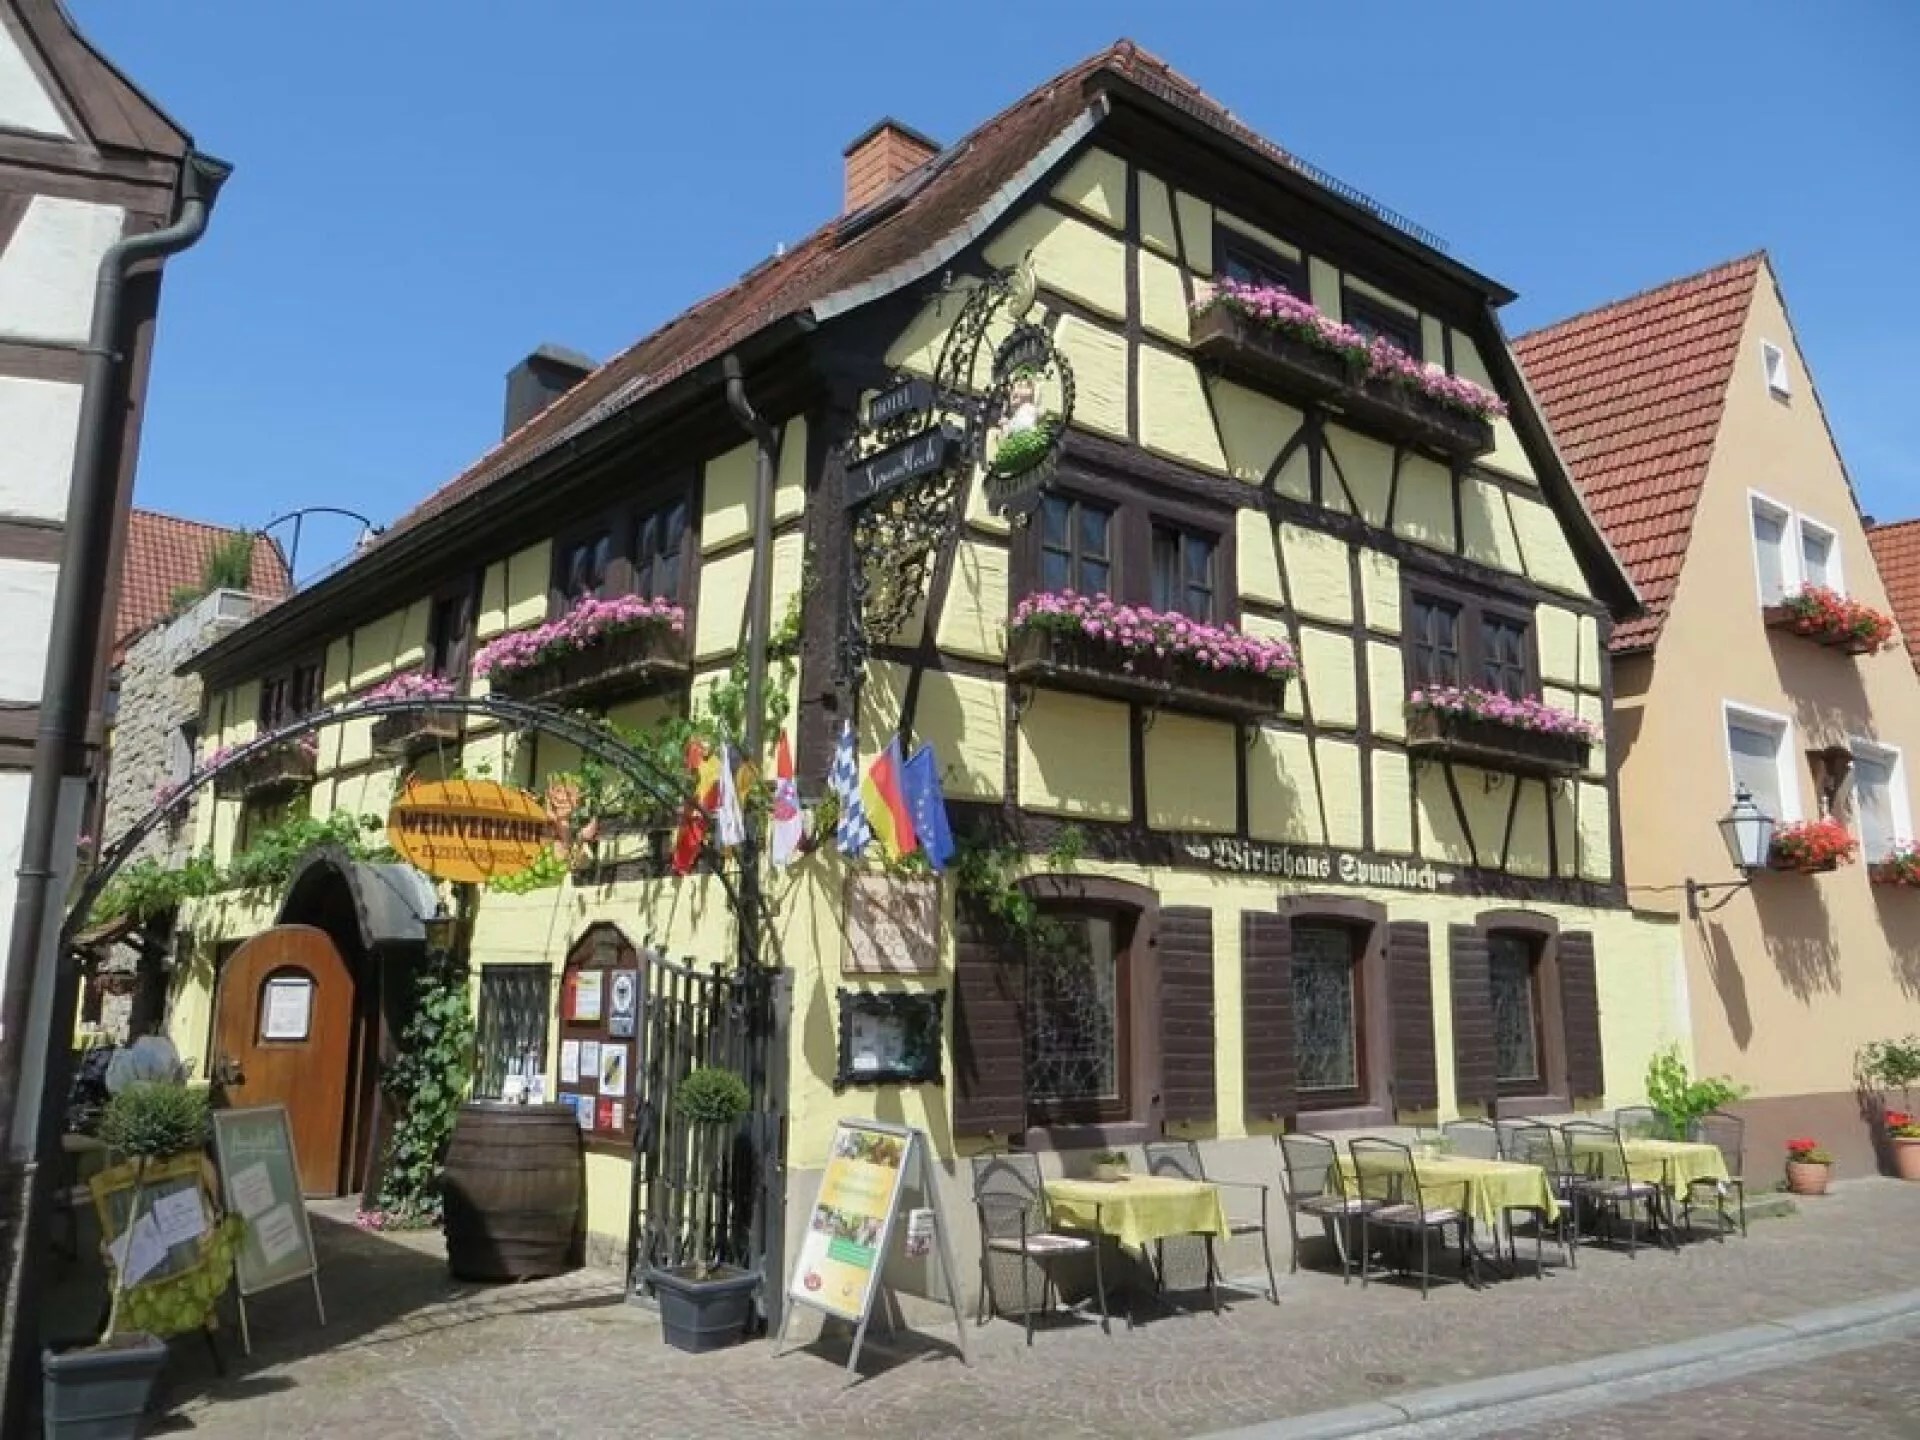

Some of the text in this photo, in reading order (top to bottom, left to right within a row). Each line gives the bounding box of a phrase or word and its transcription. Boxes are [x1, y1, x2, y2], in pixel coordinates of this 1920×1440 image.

[400, 809, 545, 845] WEINVERKAUF
[1211, 838, 1436, 890] Wirtshaus Spundloch
